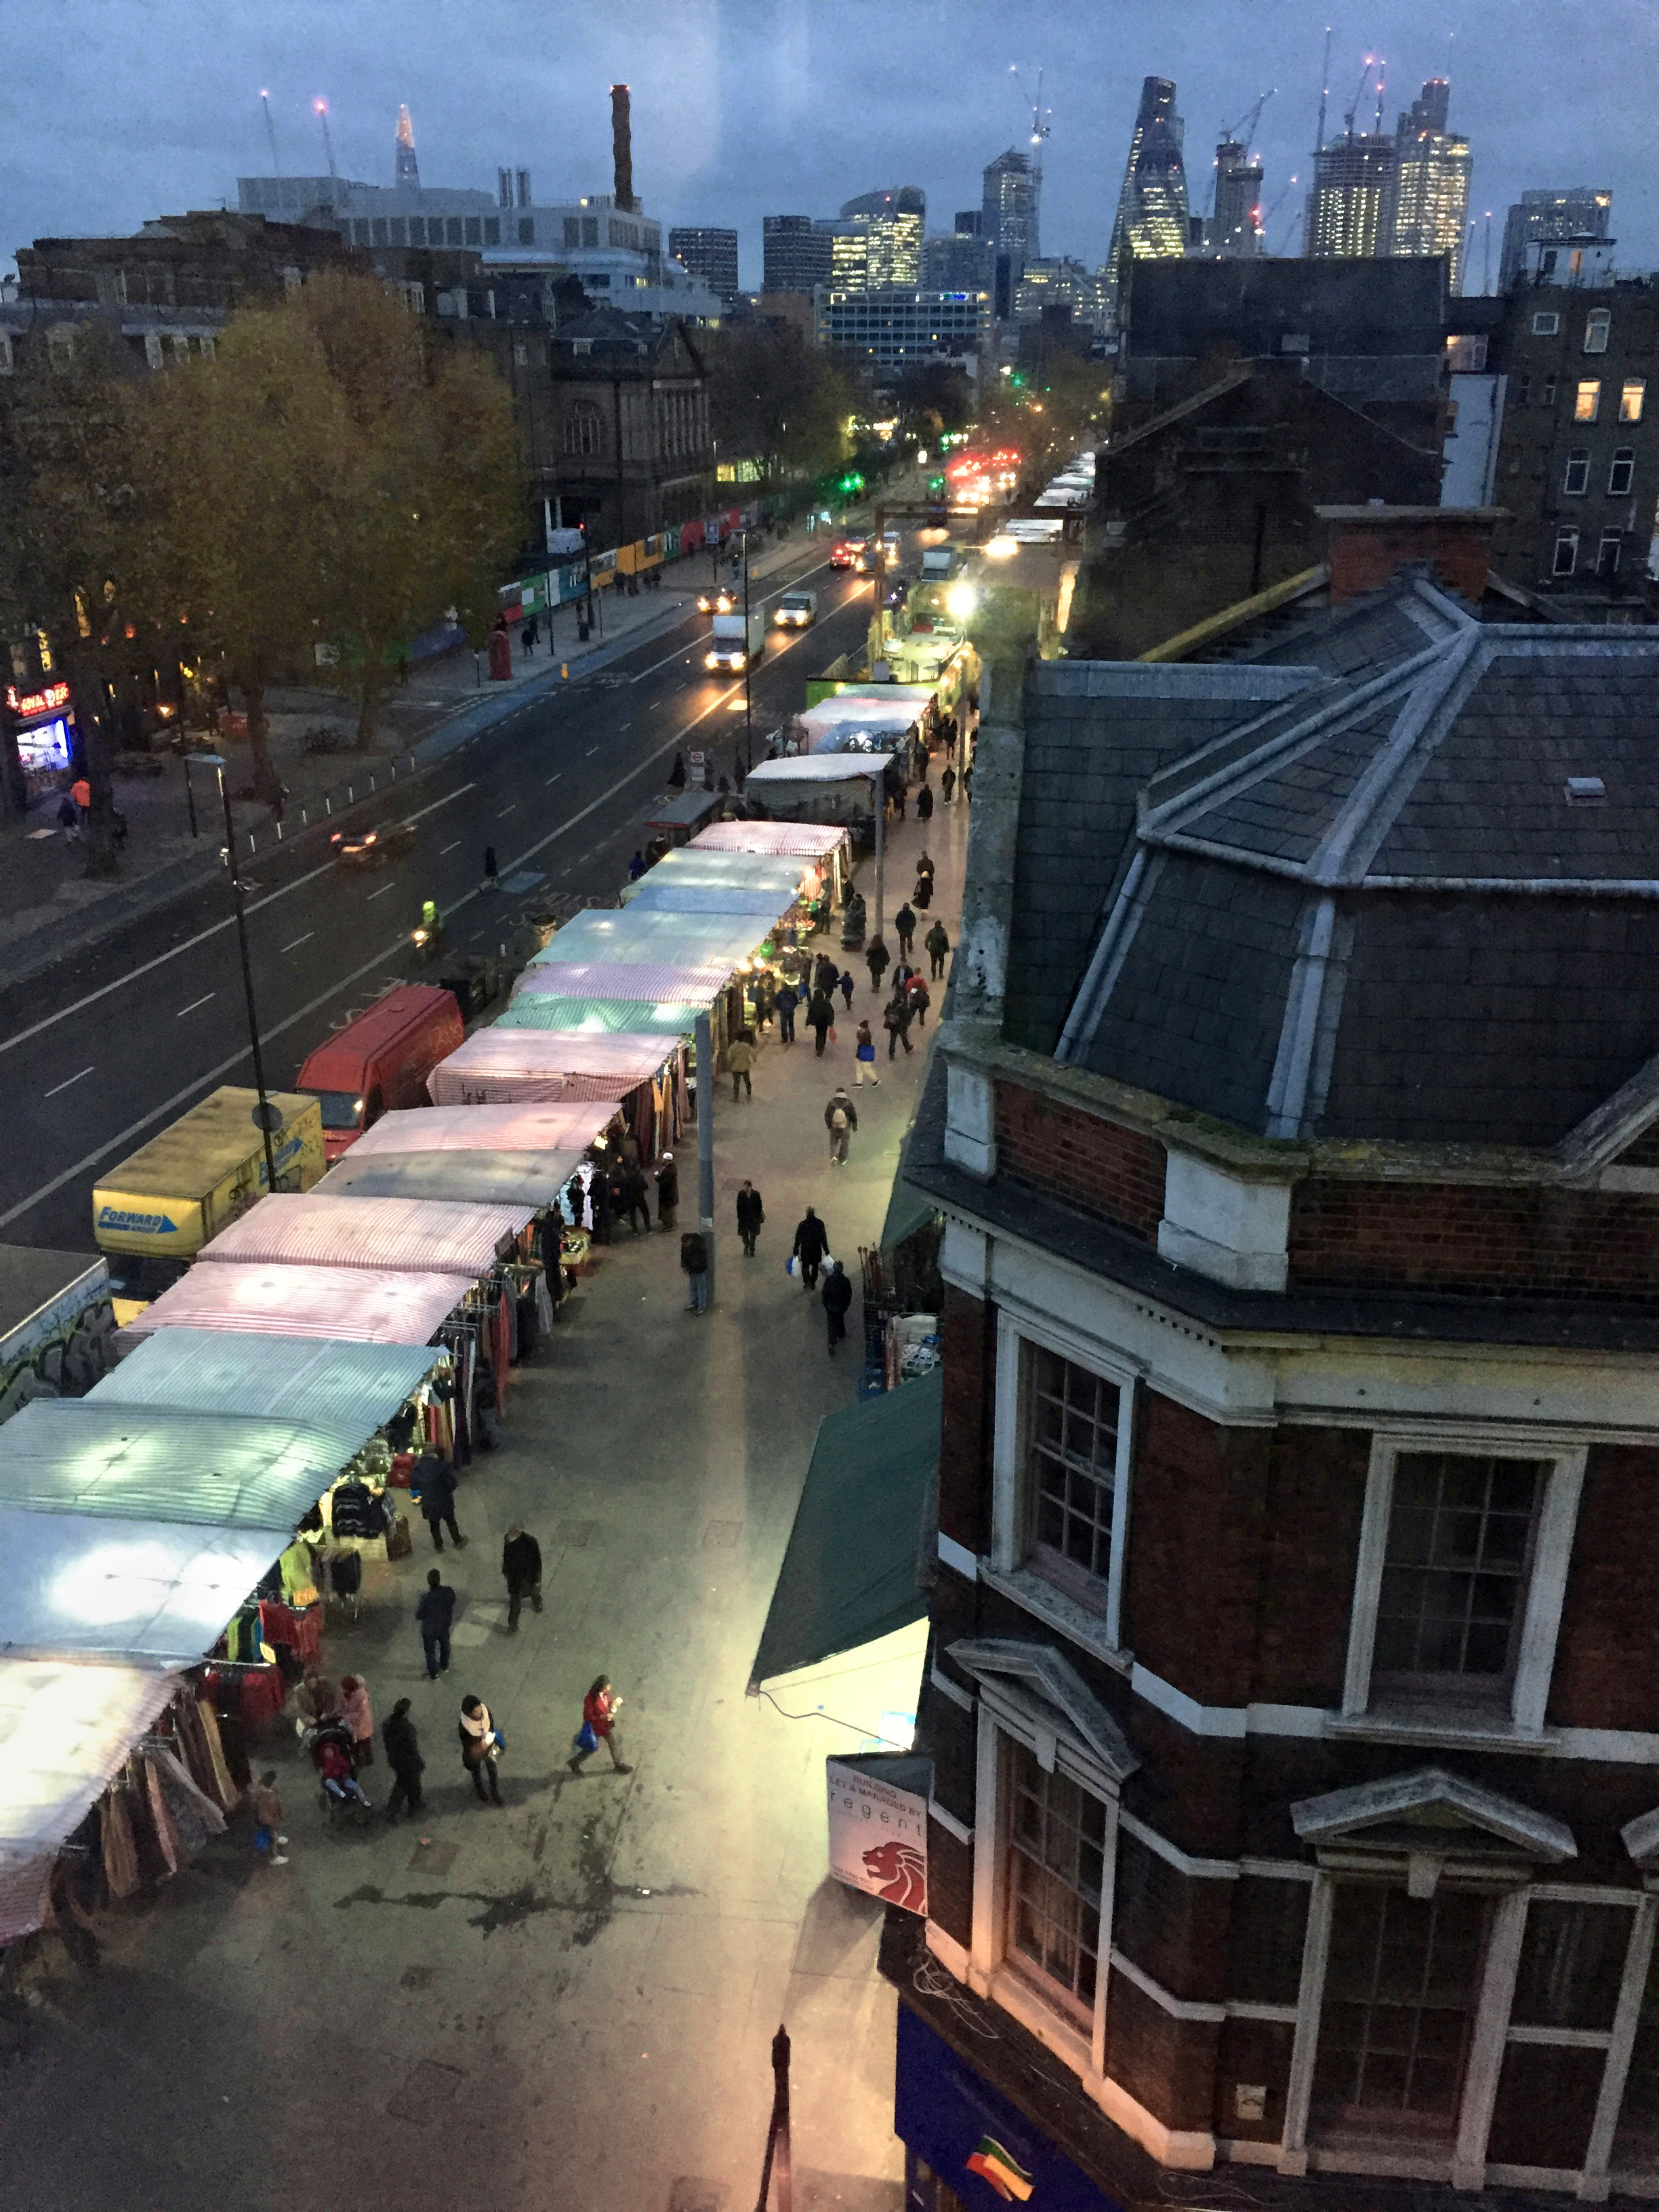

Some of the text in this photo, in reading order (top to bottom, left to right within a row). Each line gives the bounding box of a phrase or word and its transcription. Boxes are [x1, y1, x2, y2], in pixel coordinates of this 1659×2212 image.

[99, 1206, 162, 1227] FORWARD
[830, 1776, 846, 1788] LET
[859, 1787, 906, 1811] MANAGED
[909, 1807, 922, 1818] BY
[853, 1775, 897, 1799] BUILDING
[830, 1790, 922, 1837] regent
